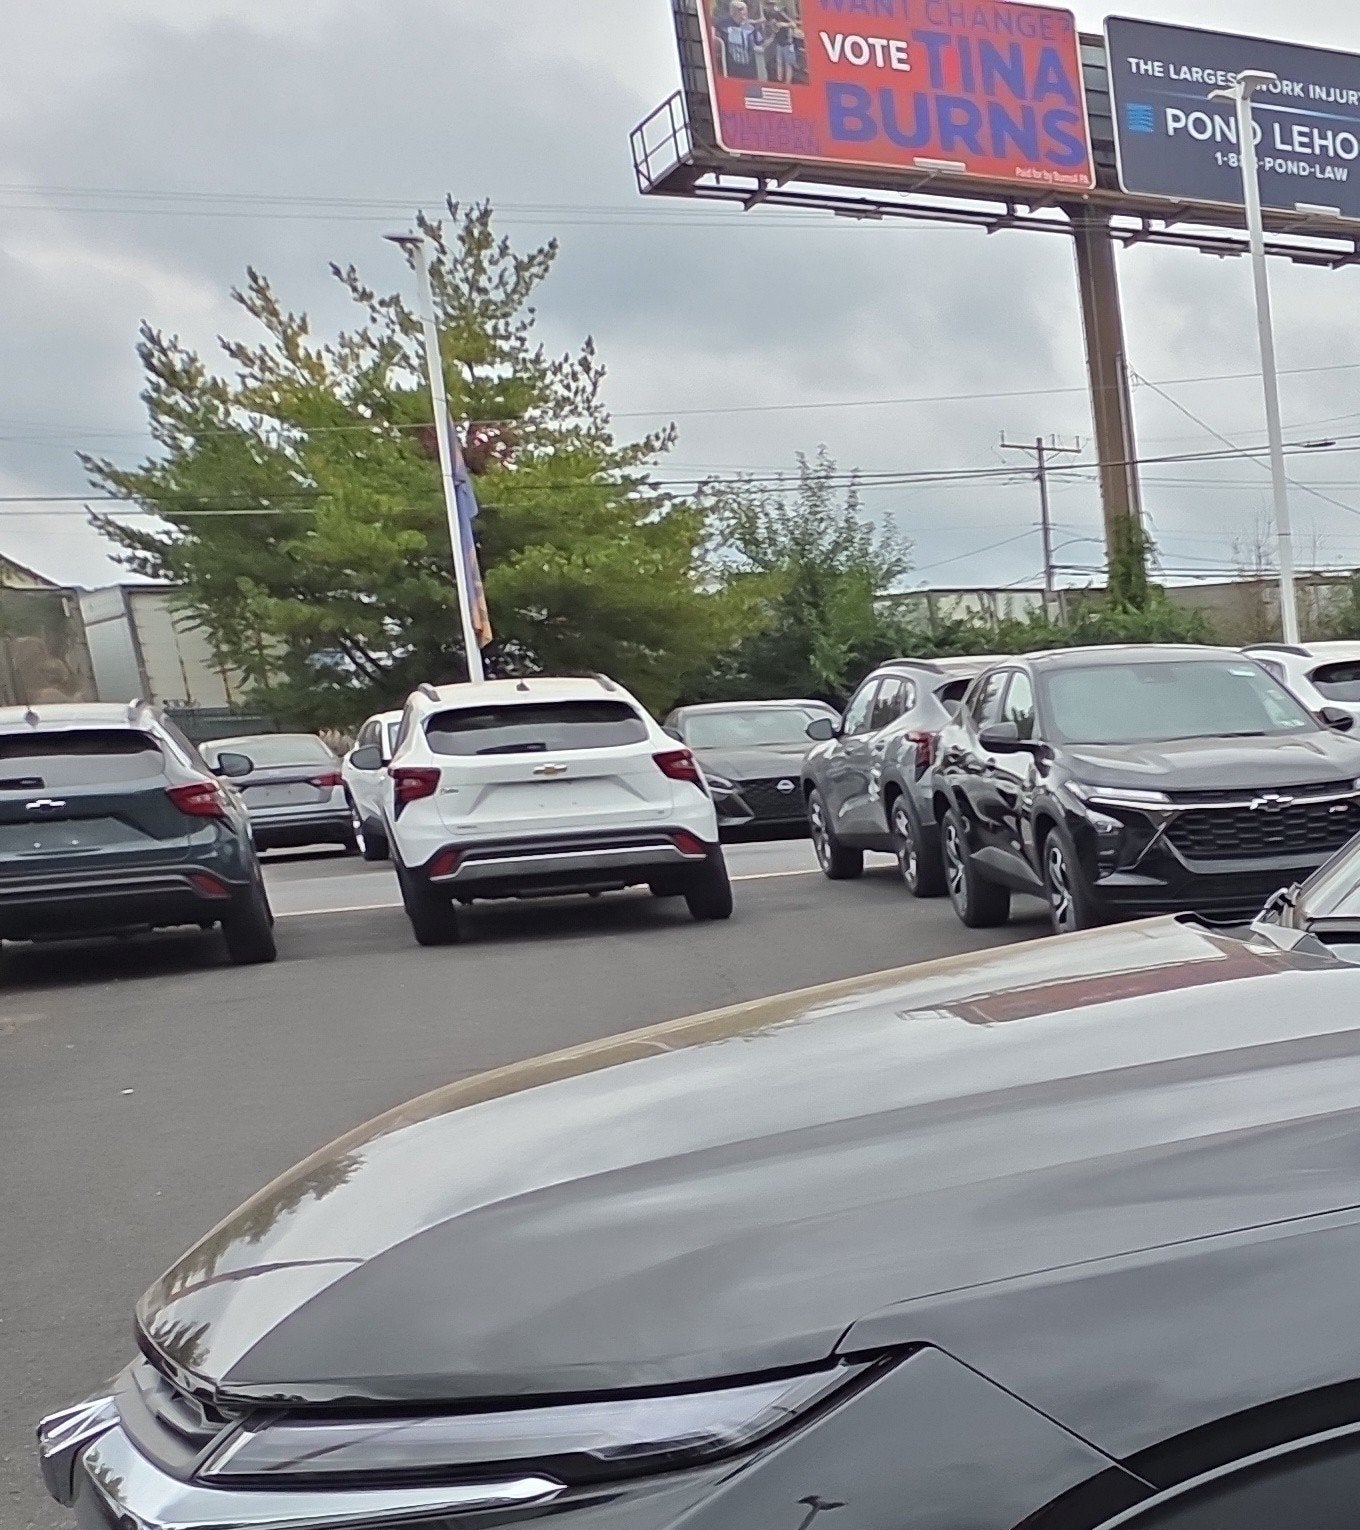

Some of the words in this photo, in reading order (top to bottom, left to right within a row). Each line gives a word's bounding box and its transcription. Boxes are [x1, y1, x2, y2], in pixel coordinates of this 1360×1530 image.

[818, 31, 911, 72] VOTE
[912, 29, 1077, 105] TINA
[1126, 57, 1165, 78] THE
[1168, 64, 1240, 87] LARGES
[1256, 79, 1305, 98] ORK
[825, 81, 1086, 167] BURNS
[1214, 151, 1348, 182] 1-8-POND-LAW
